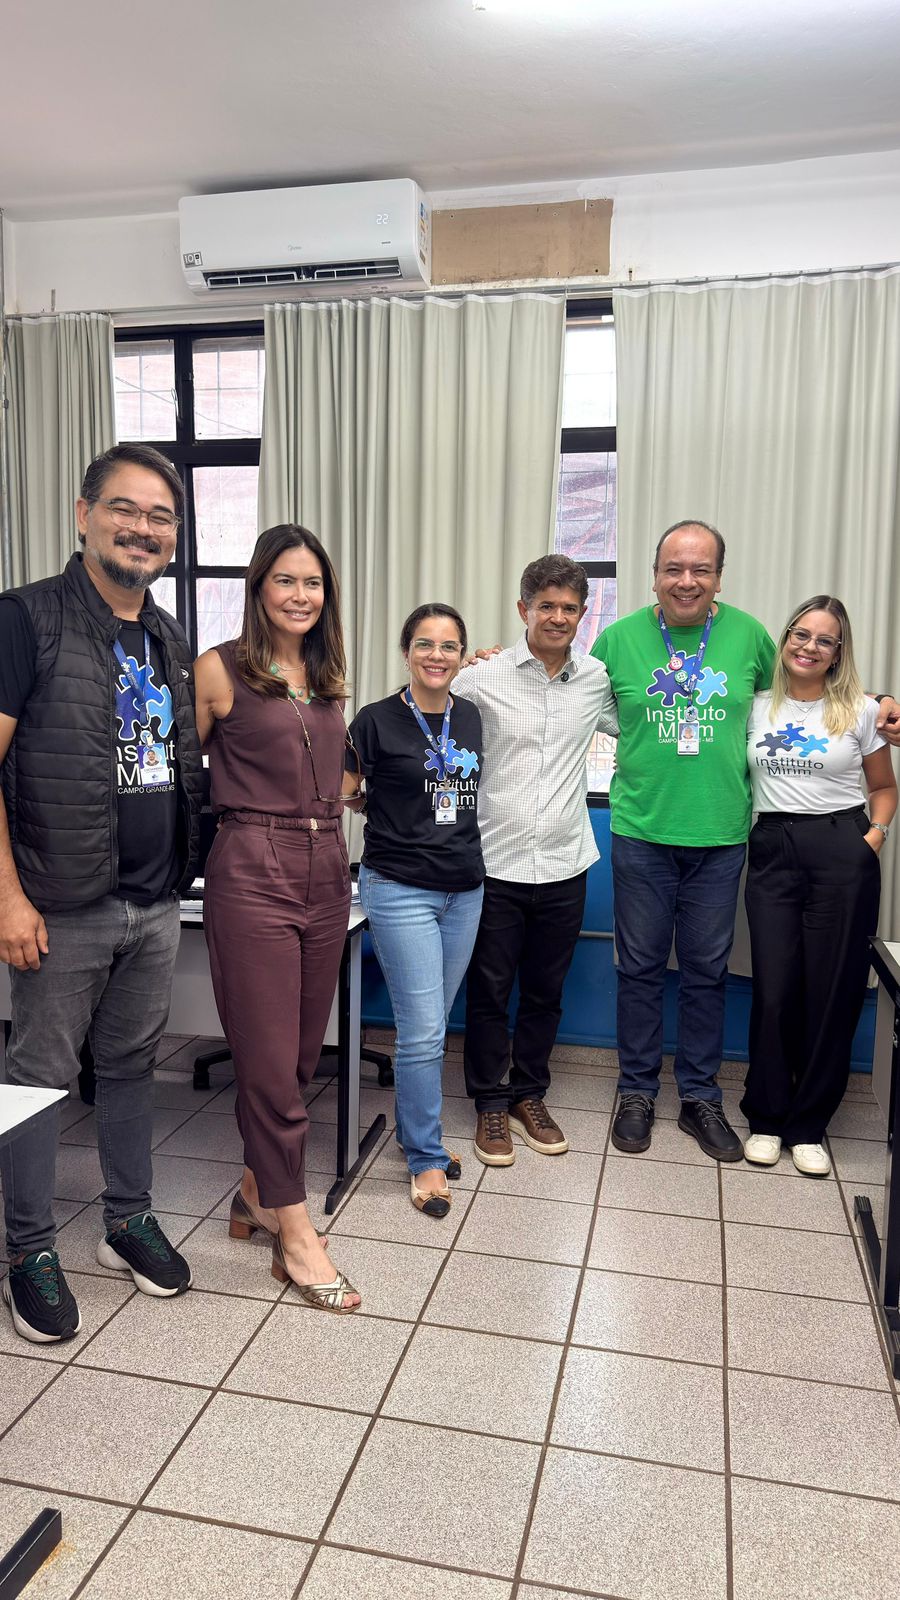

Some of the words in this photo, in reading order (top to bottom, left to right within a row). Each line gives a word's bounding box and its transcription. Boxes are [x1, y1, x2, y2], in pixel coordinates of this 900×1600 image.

[376, 213, 389, 225] 22
[755, 756, 824, 770] Instituto
[767, 766, 812, 776] Mirim
